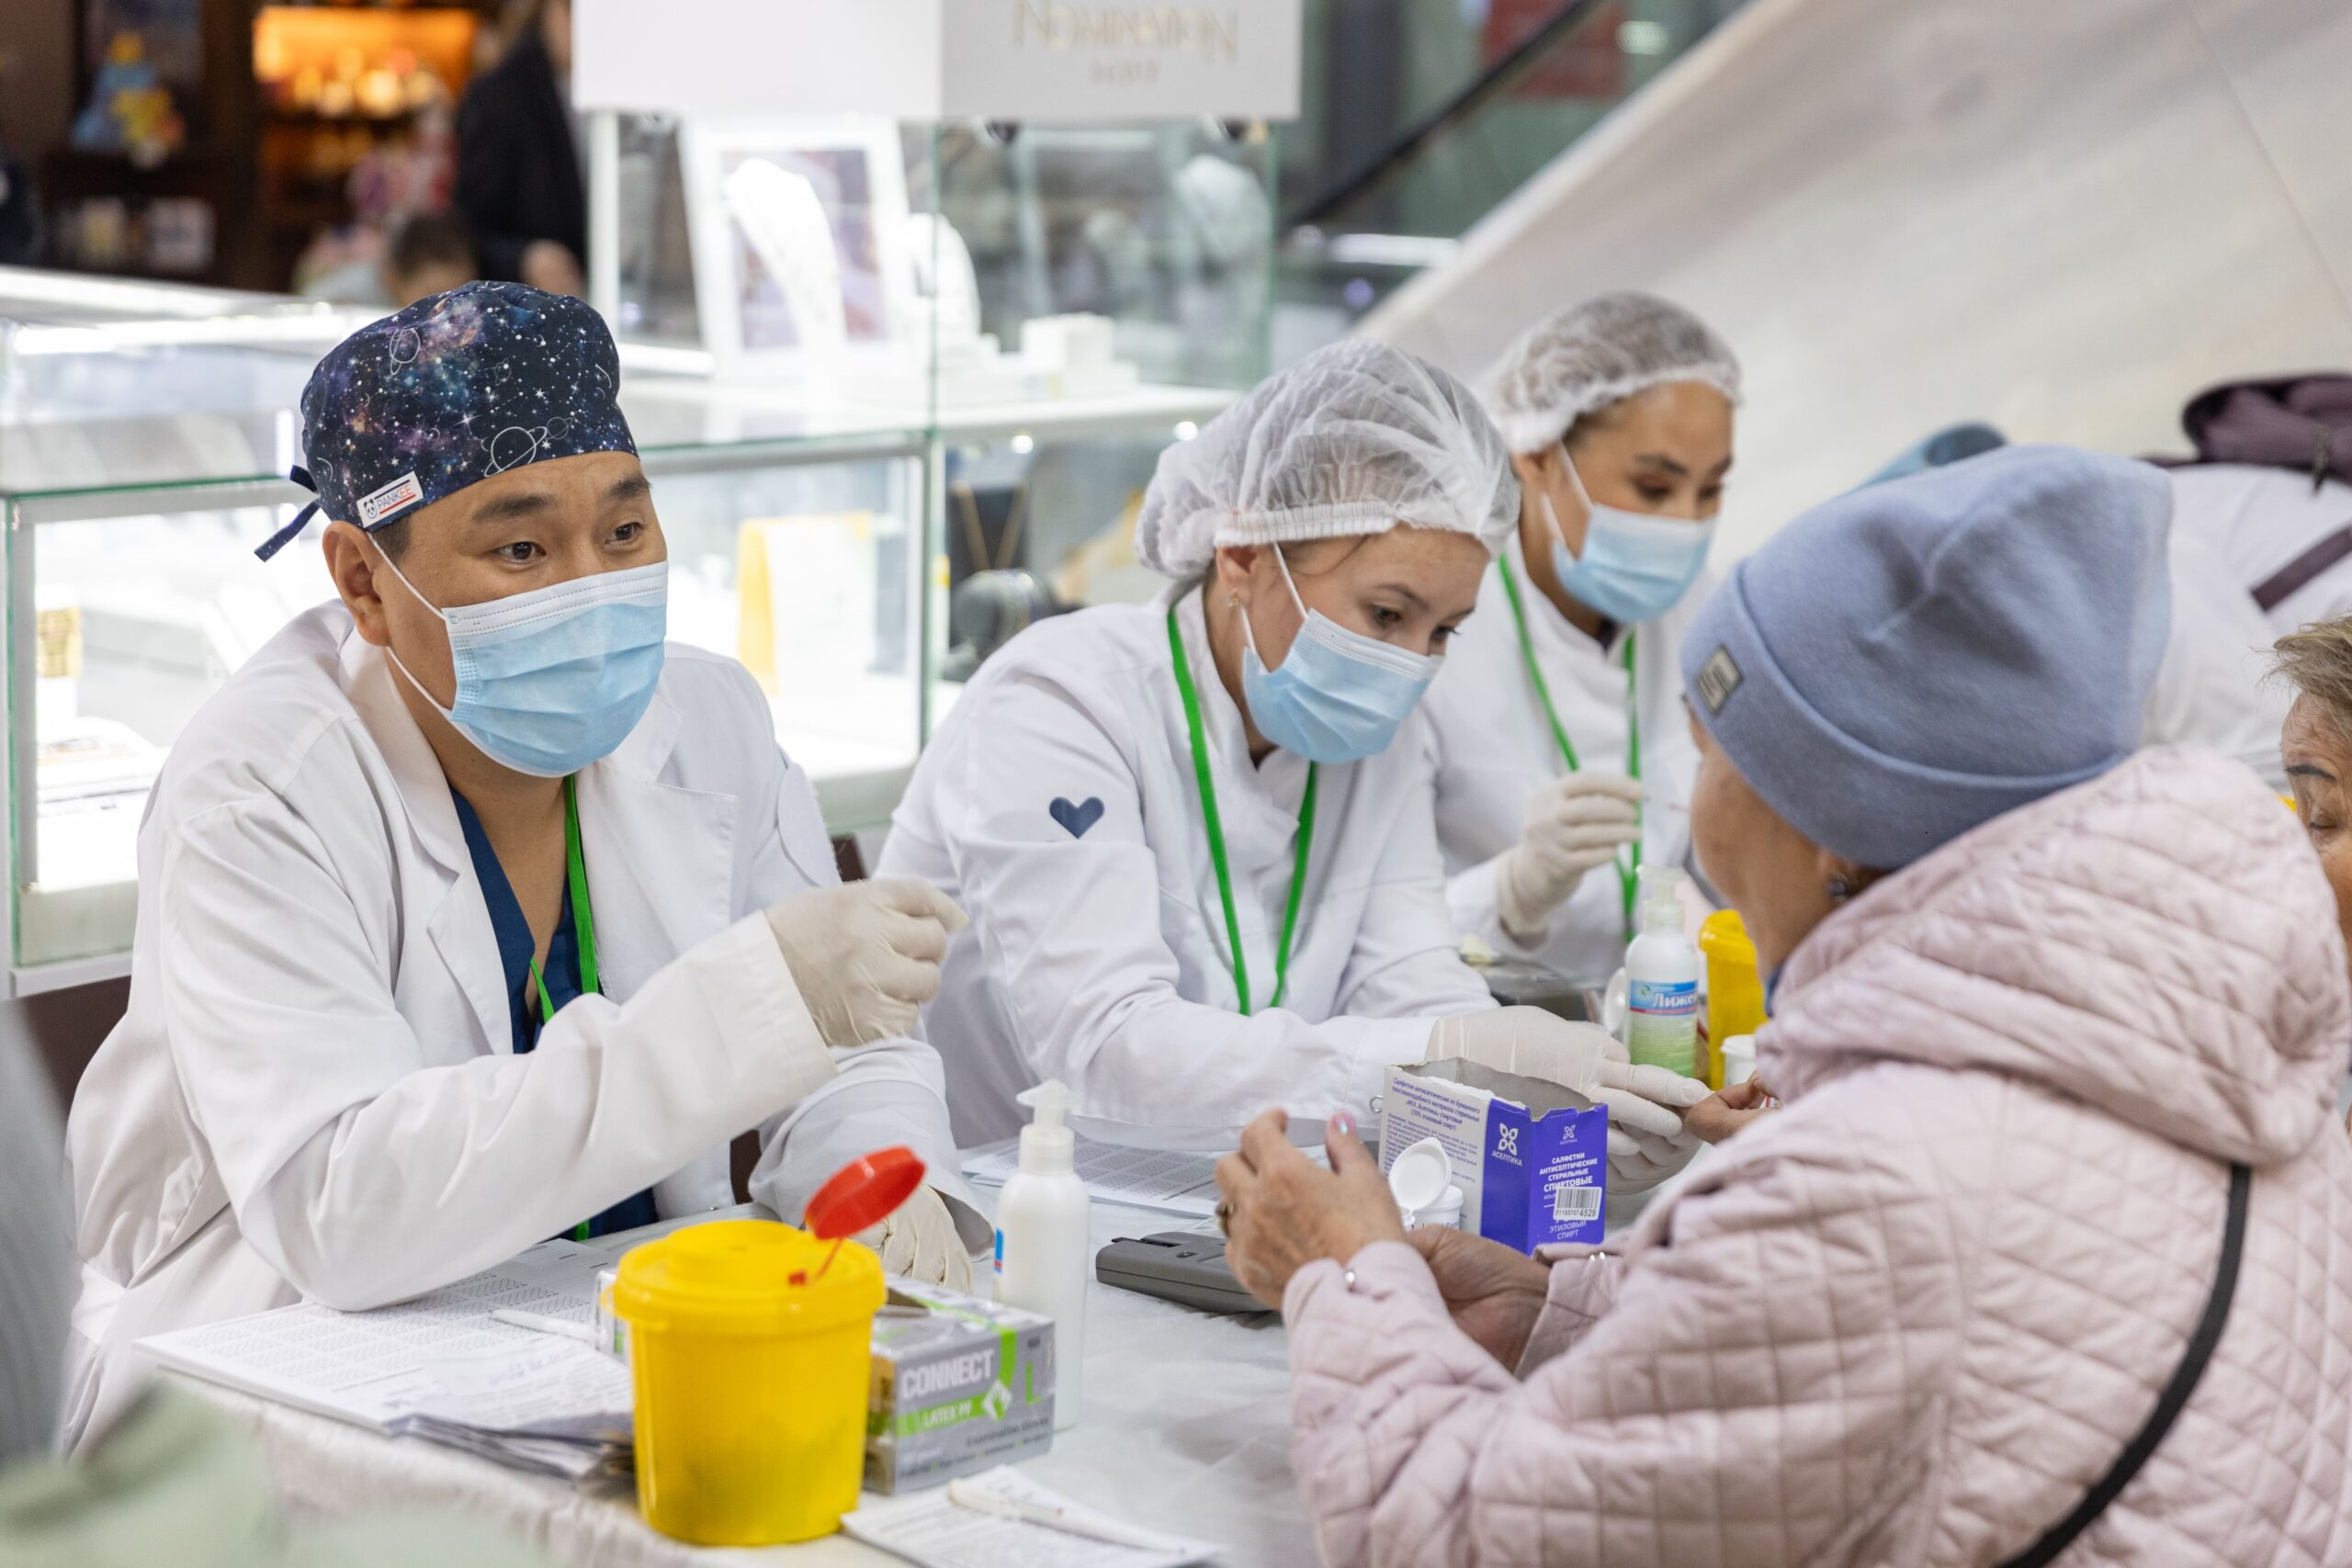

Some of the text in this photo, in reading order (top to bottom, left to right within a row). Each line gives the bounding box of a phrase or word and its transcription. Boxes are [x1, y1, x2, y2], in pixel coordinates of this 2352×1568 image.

[377, 484, 413, 510] PANKEE
[1394, 1077, 1414, 1090] Салфетки
[1415, 1085, 1450, 1102] антисептические
[1431, 1101, 1454, 1113] материала
[1492, 1150, 1522, 1168] АСЕПТИКА
[1552, 1152, 1586, 1164] САЛФЕТКИ
[1539, 1158, 1598, 1176] АНТИСЕПТИЧЕСКИЕ
[1548, 1168, 1589, 1181] СТЕРИЛЬНЫЕ
[1544, 1176, 1593, 1192] СПИРТОВЫЕ
[1549, 1220, 1587, 1234] ЭТИЛОВЫЙ
[1557, 1230, 1579, 1240] СПИРТ
[901, 1348, 995, 1399] CONNECT
[922, 1404, 958, 1427] LATEX
